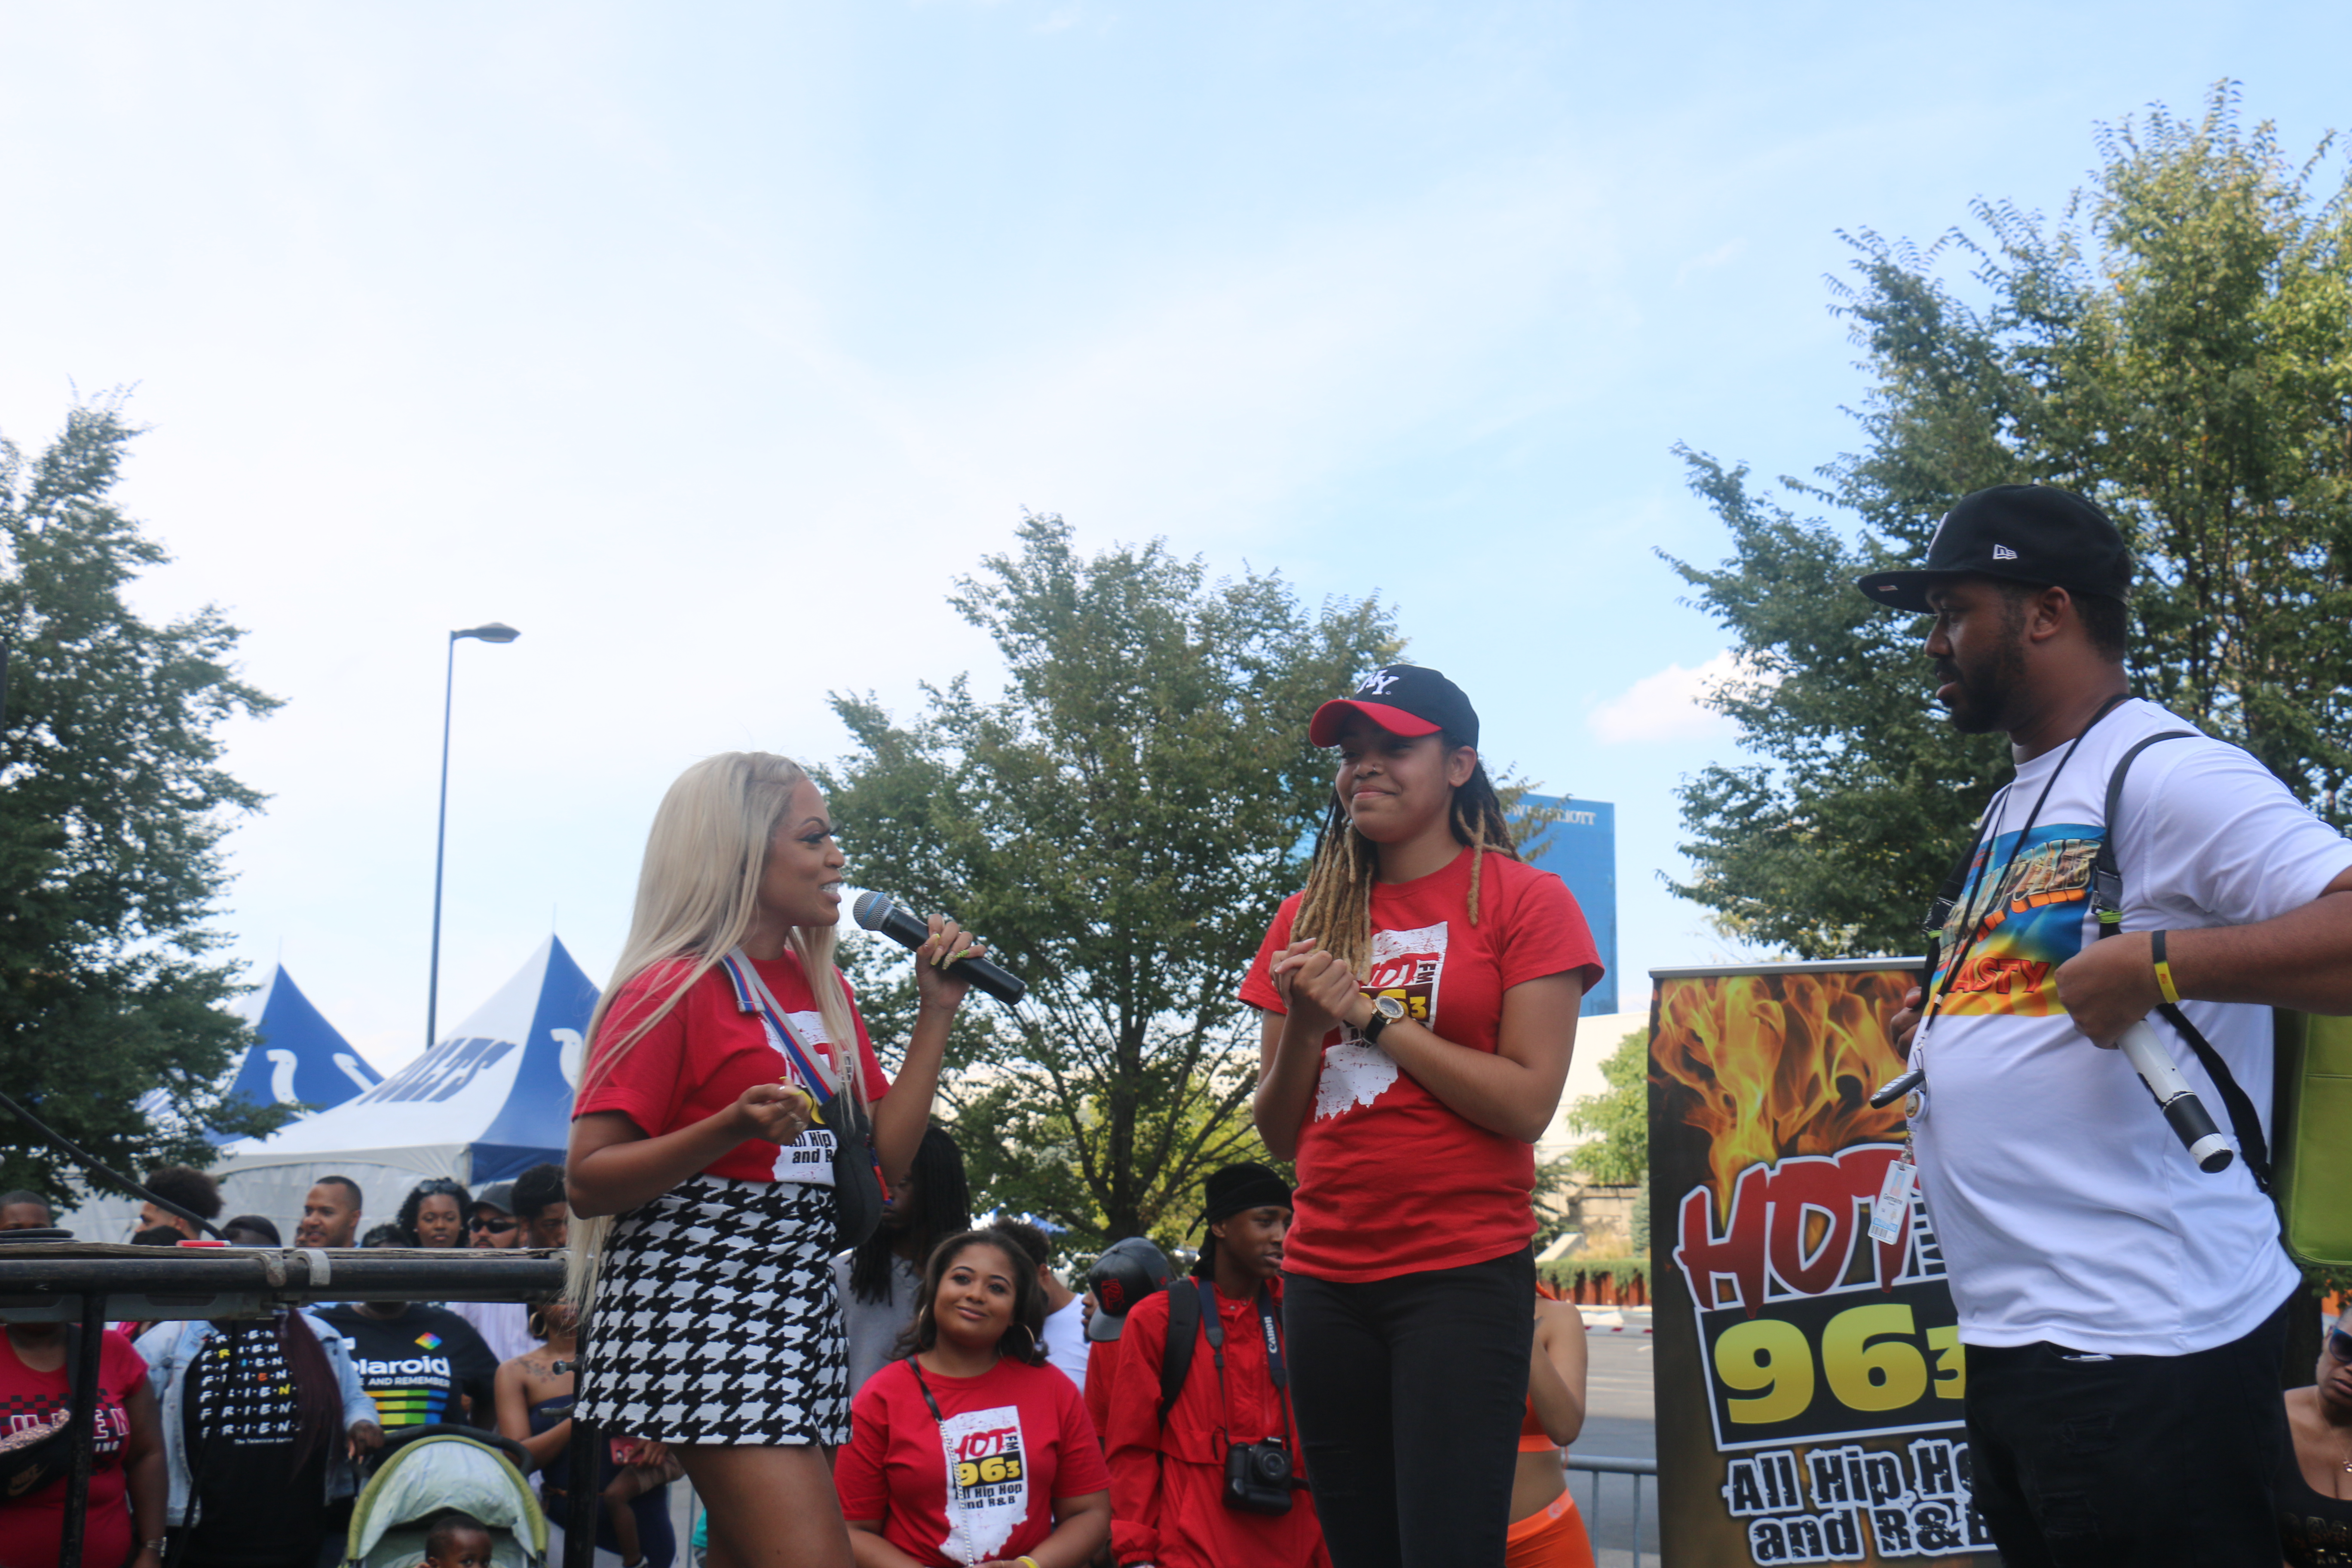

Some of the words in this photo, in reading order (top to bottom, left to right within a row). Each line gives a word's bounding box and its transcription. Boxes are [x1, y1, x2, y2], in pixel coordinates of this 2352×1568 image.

[1944, 957, 2051, 994] ASTY
[792, 1148, 820, 1164] and
[808, 1131, 833, 1148] Hip
[1674, 1144, 1921, 1318] HOT
[1264, 1316, 1277, 1354] Canon
[1714, 1304, 1966, 1424] 963
[368, 1377, 393, 1386] AND
[394, 1376, 450, 1388] REMEMBER
[1005, 1436, 1019, 1451] FM
[958, 1456, 1021, 1487] 963
[1724, 1451, 1804, 1516] All
[1807, 1445, 1911, 1509] Hip
[975, 1486, 994, 1498] Hip
[999, 1483, 1023, 1495] Hop
[1749, 1506, 1864, 1565] and
